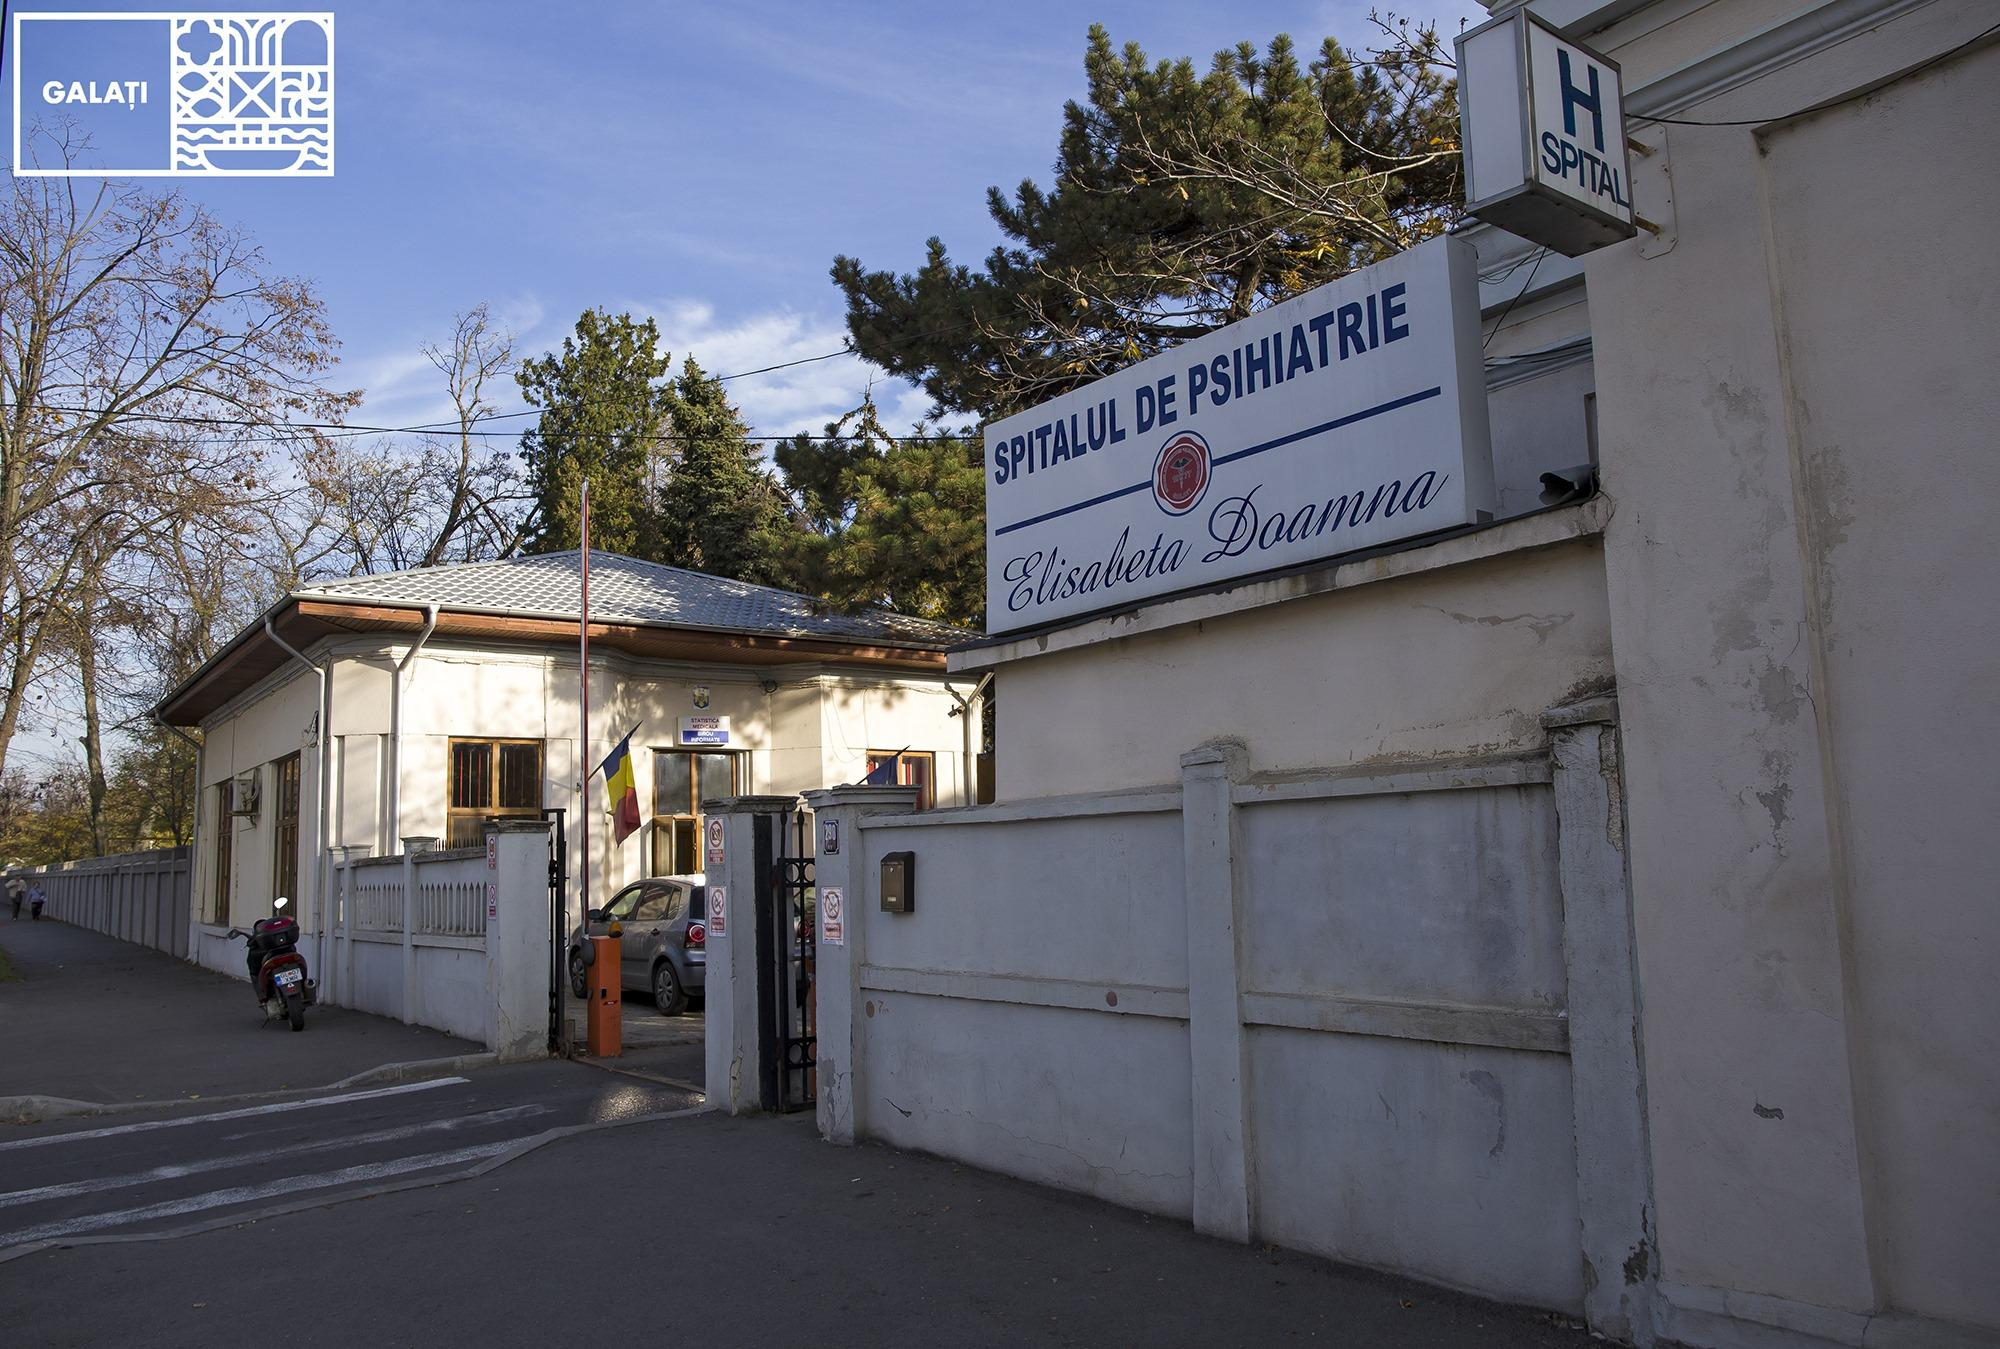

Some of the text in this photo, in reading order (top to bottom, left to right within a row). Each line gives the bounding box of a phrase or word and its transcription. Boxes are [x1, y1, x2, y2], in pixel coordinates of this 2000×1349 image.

[1557, 48, 1605, 154] H
[1541, 130, 1630, 208] SPITAL
[994, 399, 1126, 485] SPITALUL
[1136, 374, 1178, 435] DE
[1188, 282, 1410, 415] PSIHIATRIE
[1003, 526, 1192, 612] Elisabeta
[1201, 471, 1449, 563] Doamna
